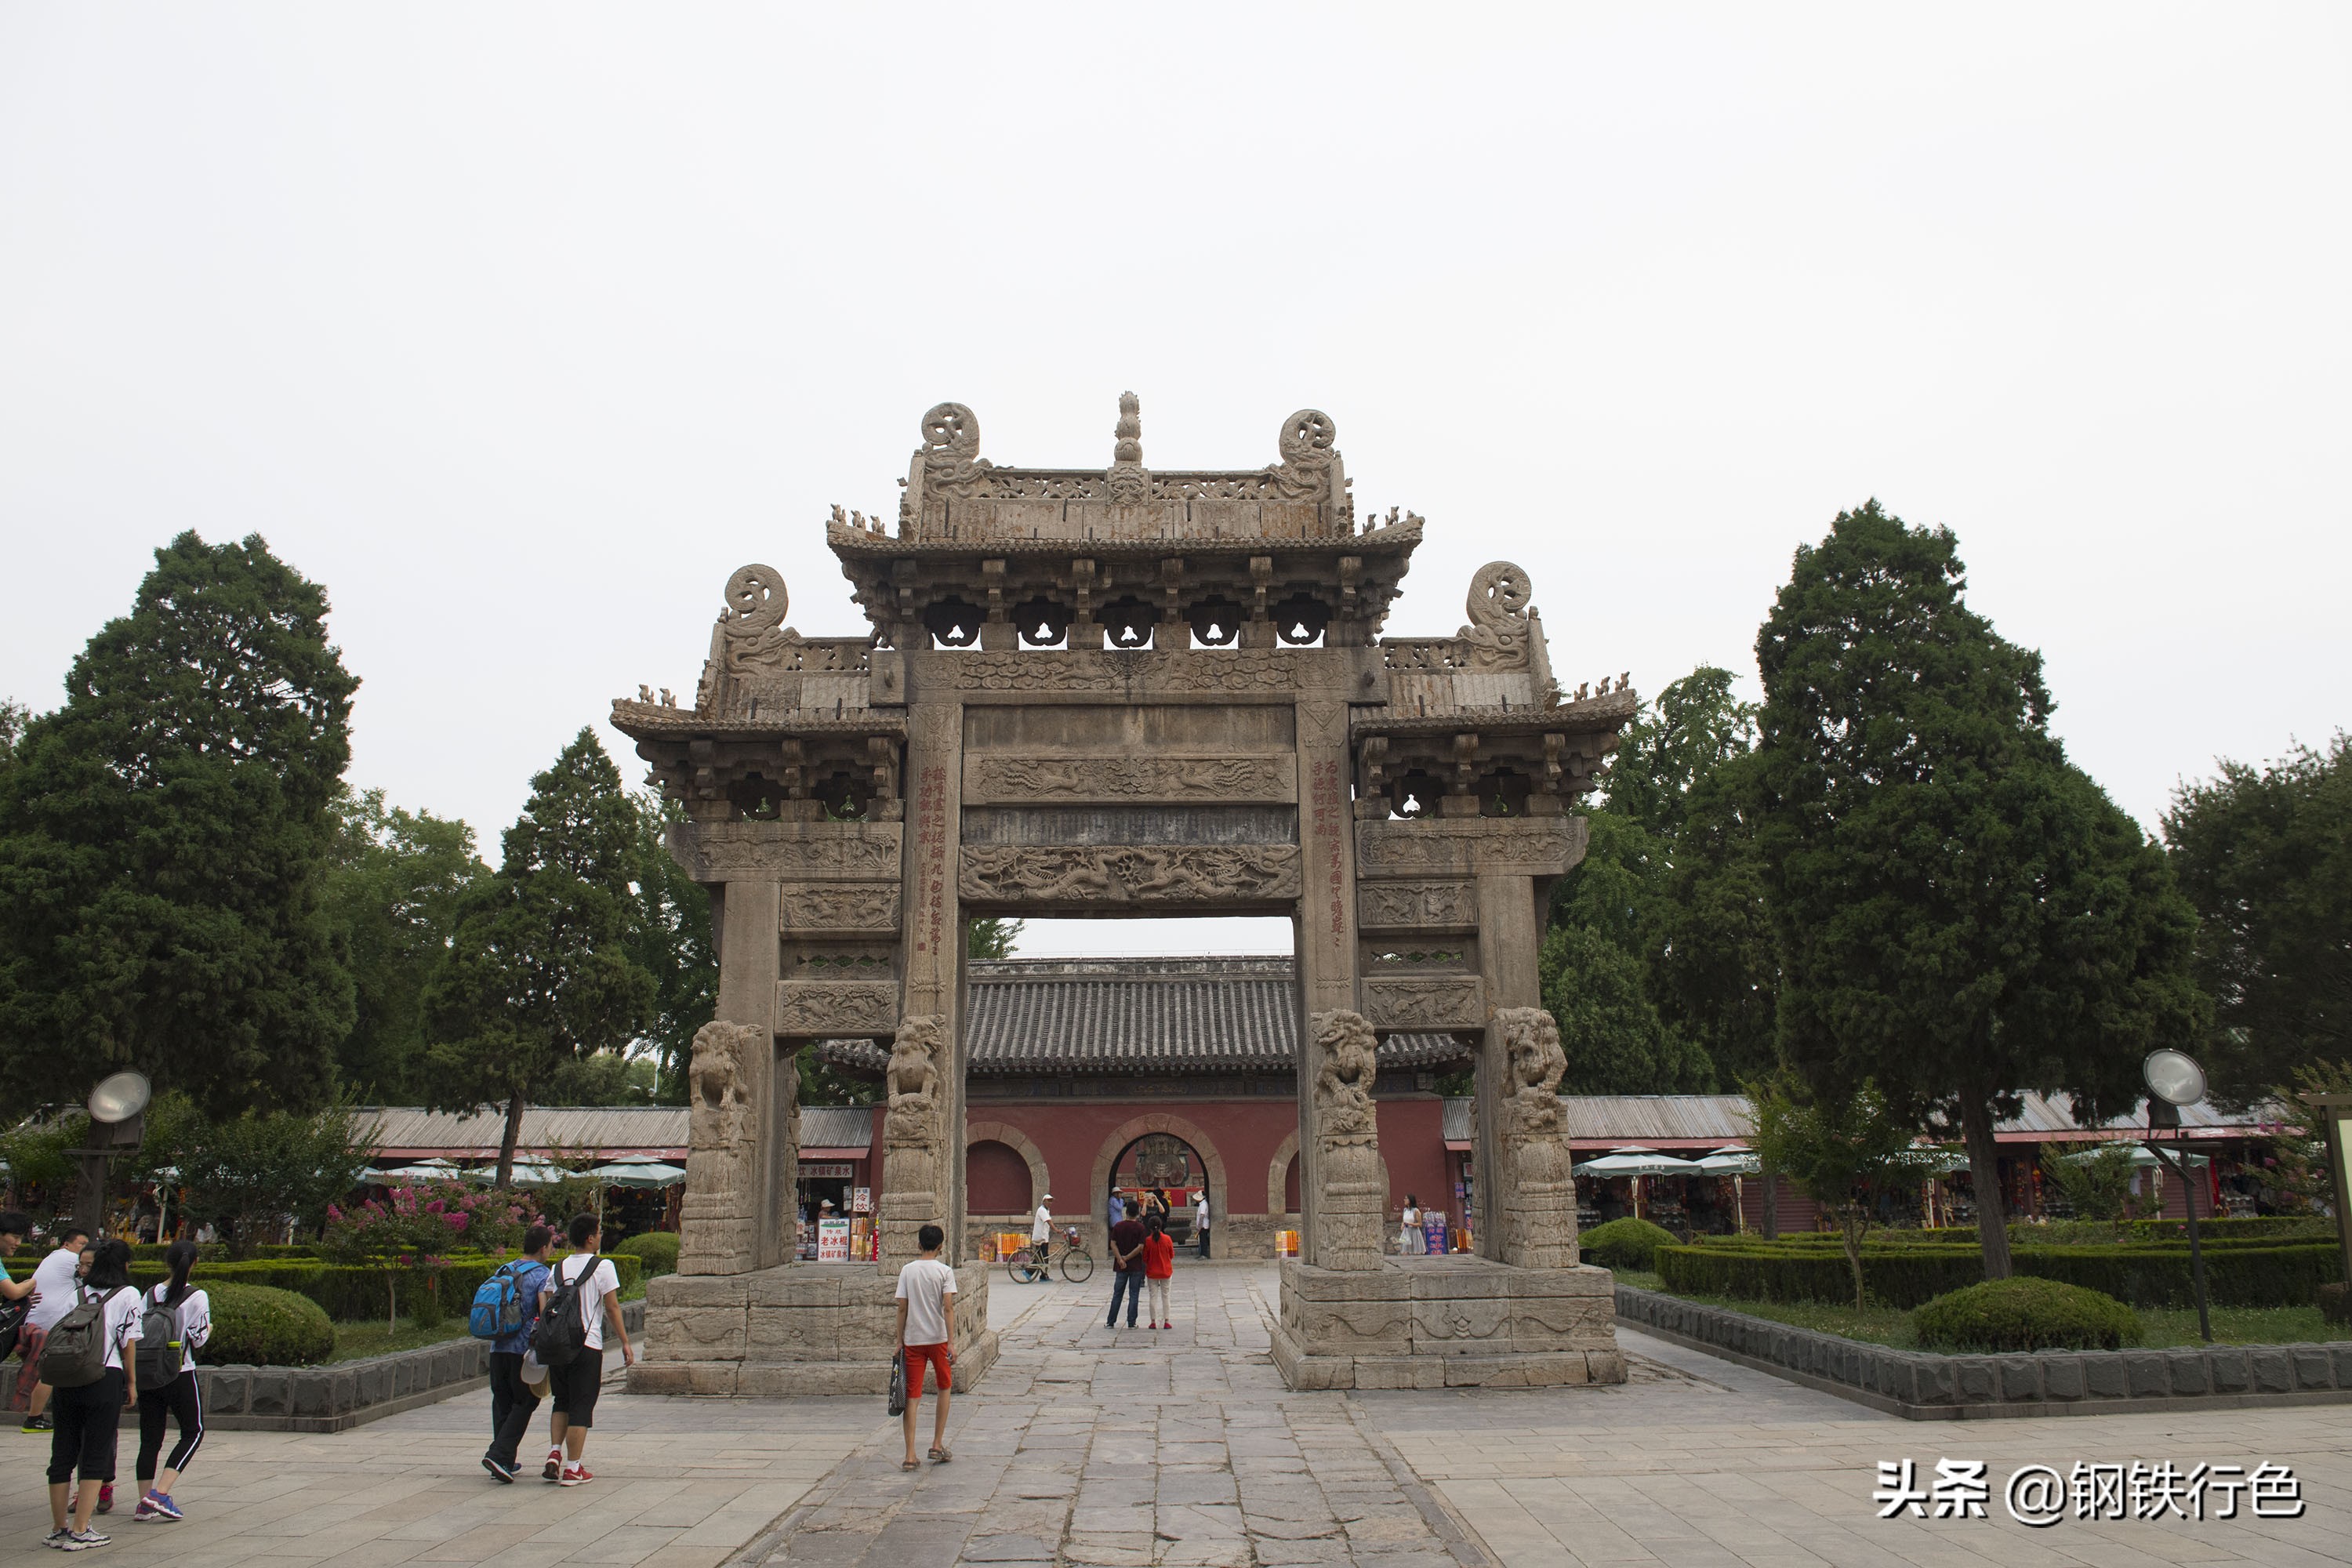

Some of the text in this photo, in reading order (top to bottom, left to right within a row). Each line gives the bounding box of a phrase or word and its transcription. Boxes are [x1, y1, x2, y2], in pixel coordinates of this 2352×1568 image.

[821, 1236, 848, 1246] 老冰棍
[820, 1250, 848, 1258] 冰镇矿泉水
